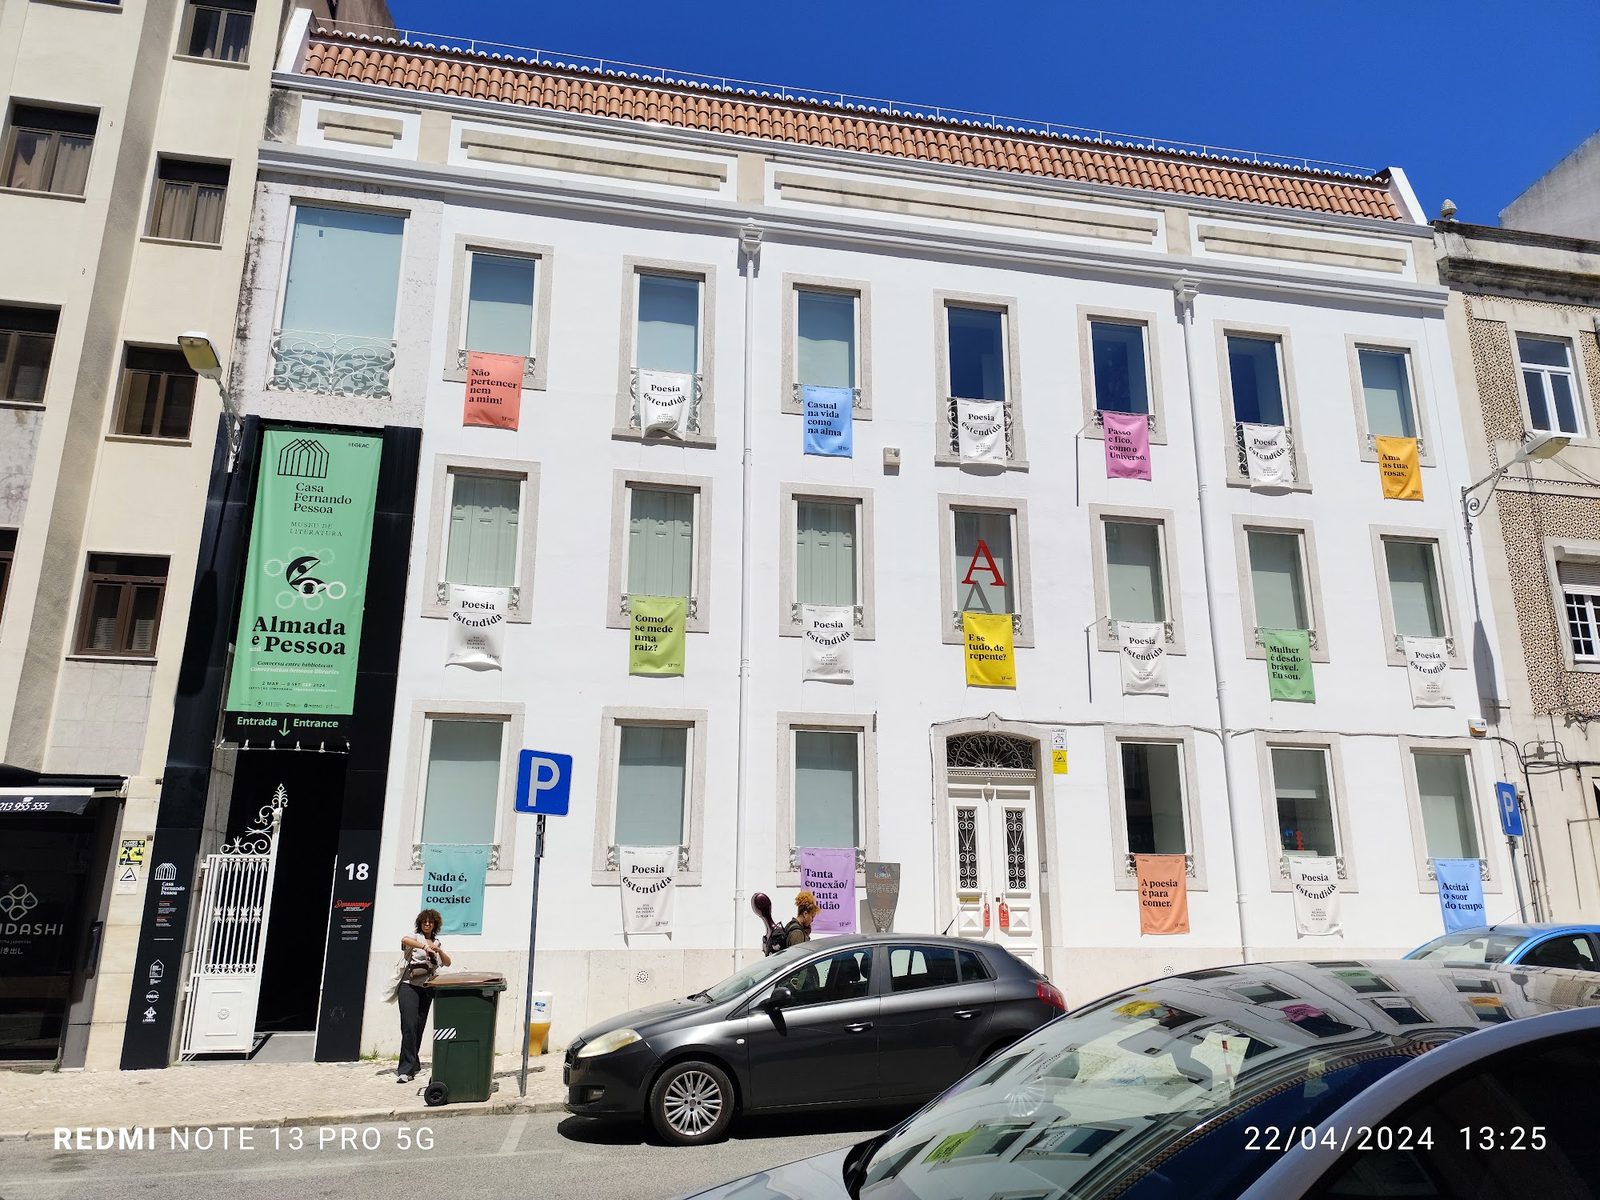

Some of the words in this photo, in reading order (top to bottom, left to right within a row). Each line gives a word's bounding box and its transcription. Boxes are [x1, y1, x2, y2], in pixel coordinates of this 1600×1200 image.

[470, 378, 517, 389] pertencer
[651, 384, 681, 392] Poesia
[476, 396, 503, 404] mim!
[643, 393, 686, 407] estendida
[807, 401, 837, 410] Casual
[820, 410, 840, 418] vida
[968, 413, 995, 421] Poesia
[820, 428, 842, 436] alma
[961, 422, 1002, 436] estendida
[1108, 427, 1131, 436] Passo
[1114, 436, 1133, 444] fico,
[1253, 438, 1278, 446] Poesia
[1109, 452, 1146, 460] Universo.
[1249, 446, 1286, 460] estendida
[295, 482, 324, 492] Casa
[294, 492, 352, 504] Fernando
[293, 503, 333, 514] Pessoa
[289, 528, 342, 536] LITERATURA
[961, 538, 1007, 586] A
[462, 600, 495, 610] Poesia
[452, 611, 502, 627] estendida
[635, 614, 664, 623] Como
[252, 616, 346, 635] Almada
[647, 625, 673, 633] mede
[806, 630, 851, 646] estendida
[1129, 637, 1156, 645] Poesia
[251, 635, 260, 646] e
[264, 636, 346, 655] Pessoa
[634, 643, 658, 651] raiz?
[969, 643, 993, 652] tudo,
[993, 644, 1004, 652] de
[1123, 646, 1163, 661] estendida
[1414, 651, 1441, 659] Poesia
[1276, 655, 1304, 663] desdo-
[1271, 663, 1299, 672] brável.
[1410, 661, 1447, 674] estendida
[1272, 671, 1283, 679] Eu
[237, 716, 278, 726] Entrada
[293, 718, 339, 728] Entrance
[528, 756, 560, 807] P
[14, 802, 32, 810] 955
[31, 802, 50, 810] 555
[1502, 791, 1514, 827] P
[345, 863, 369, 880] 18
[631, 864, 665, 874] Poesia
[804, 868, 833, 879] Tanta
[428, 872, 456, 882] Nada
[458, 872, 467, 882] é,
[1301, 873, 1329, 881] Poesia
[427, 883, 453, 892] tudo
[622, 876, 672, 894] estendida
[804, 879, 848, 889] conexão/
[1141, 879, 1148, 887] A
[1149, 879, 1178, 888] poesia
[1442, 883, 1469, 891] Aceitai
[812, 891, 838, 900] tanta
[1142, 888, 1147, 896] é
[1149, 890, 1169, 898] para
[1296, 883, 1336, 899] estendida
[426, 895, 471, 904] coexiste
[1142, 899, 1172, 907] comer.
[816, 901, 840, 910] lidão
[1445, 902, 1456, 910] do
[1458, 903, 1483, 911] tempo
